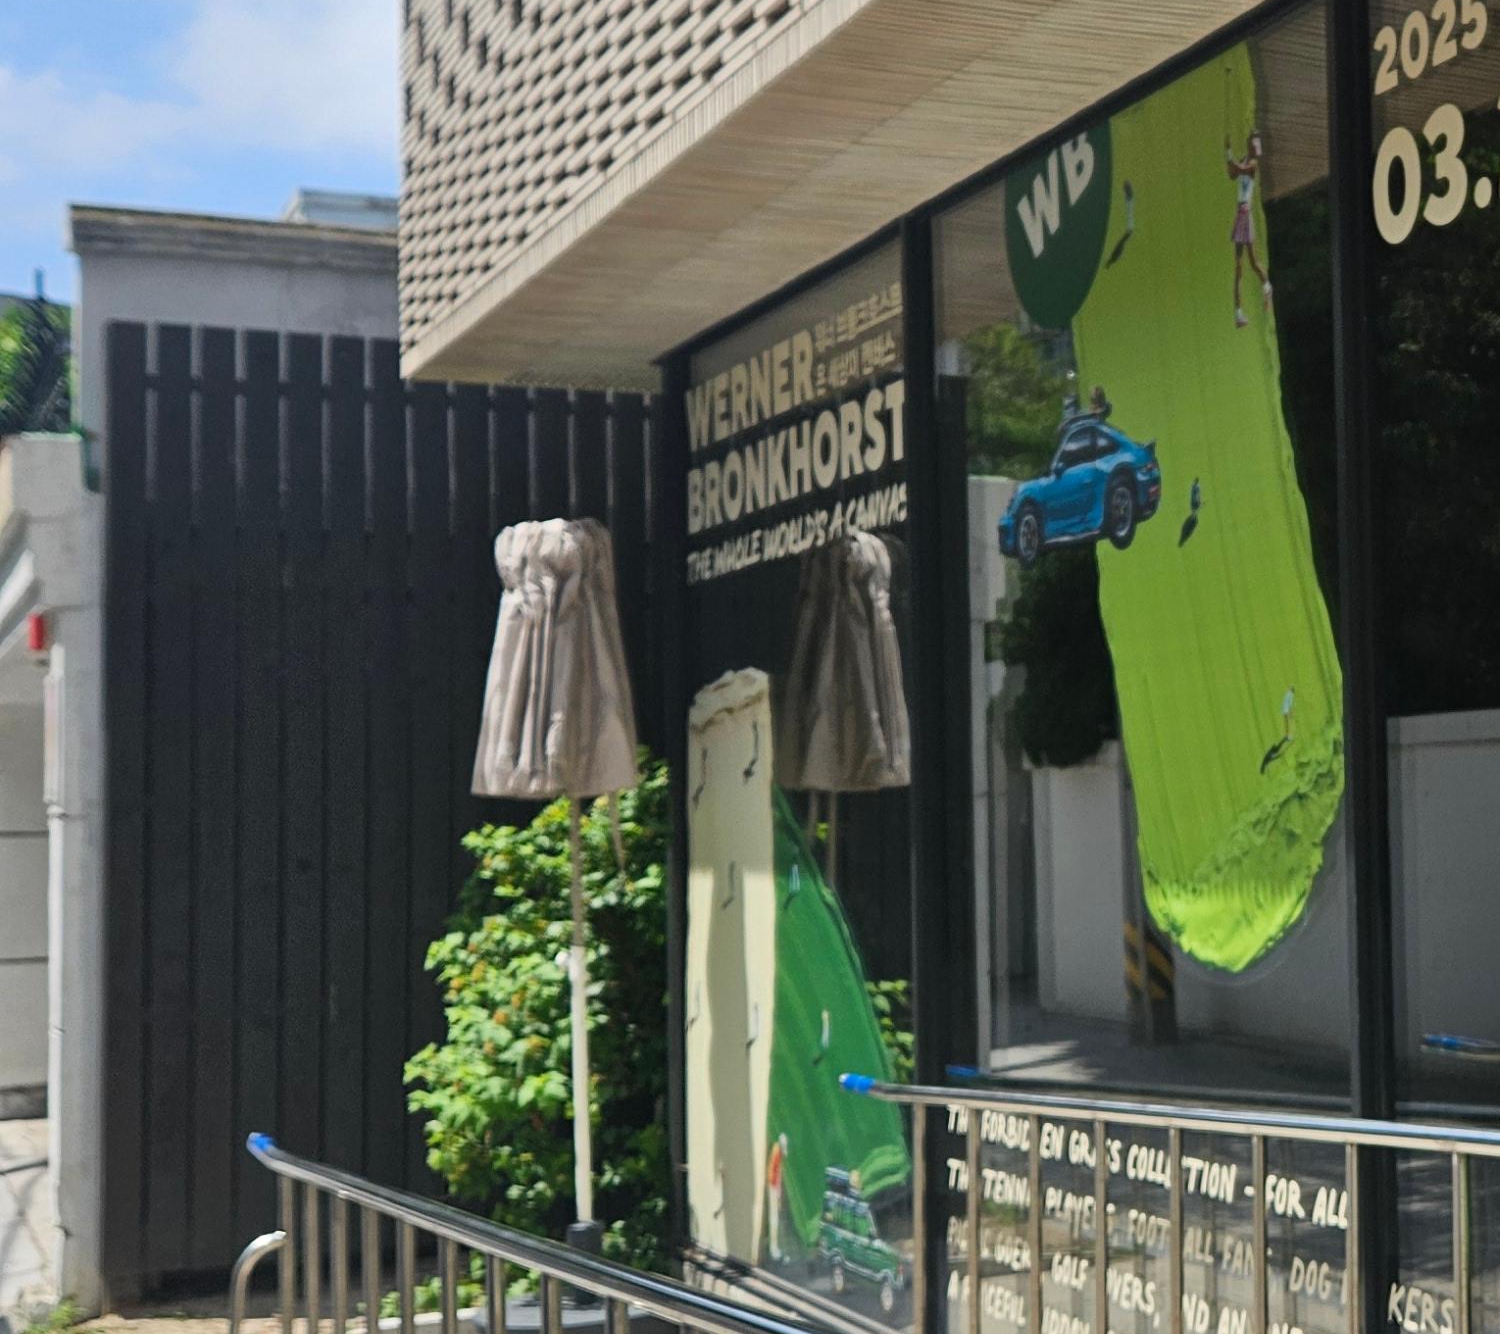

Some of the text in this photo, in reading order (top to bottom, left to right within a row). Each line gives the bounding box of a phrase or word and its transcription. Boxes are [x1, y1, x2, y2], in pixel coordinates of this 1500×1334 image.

[1016, 131, 1096, 259] WB
[685, 328, 815, 453] WERNER
[686, 379, 905, 536] BRONKHORST
[686, 482, 908, 586] THE WHOLE WORLD'S A CANVAS
[946, 1104, 970, 1135] TH
[1068, 1130, 1121, 1174] GRS
[1126, 1143, 1237, 1204] COLLTION
[1264, 1173, 1305, 1220] FOR
[1311, 1185, 1348, 1230] ALL
[946, 1157, 970, 1192] TH
[981, 1167, 1031, 1208] TENN
[1128, 1208, 1214, 1265] FOOTALL
[1288, 1255, 1331, 1301] DOG
[946, 1269, 958, 1300] A
[1051, 1251, 1089, 1291] GOLF
[1181, 1291, 1209, 1334] ND
